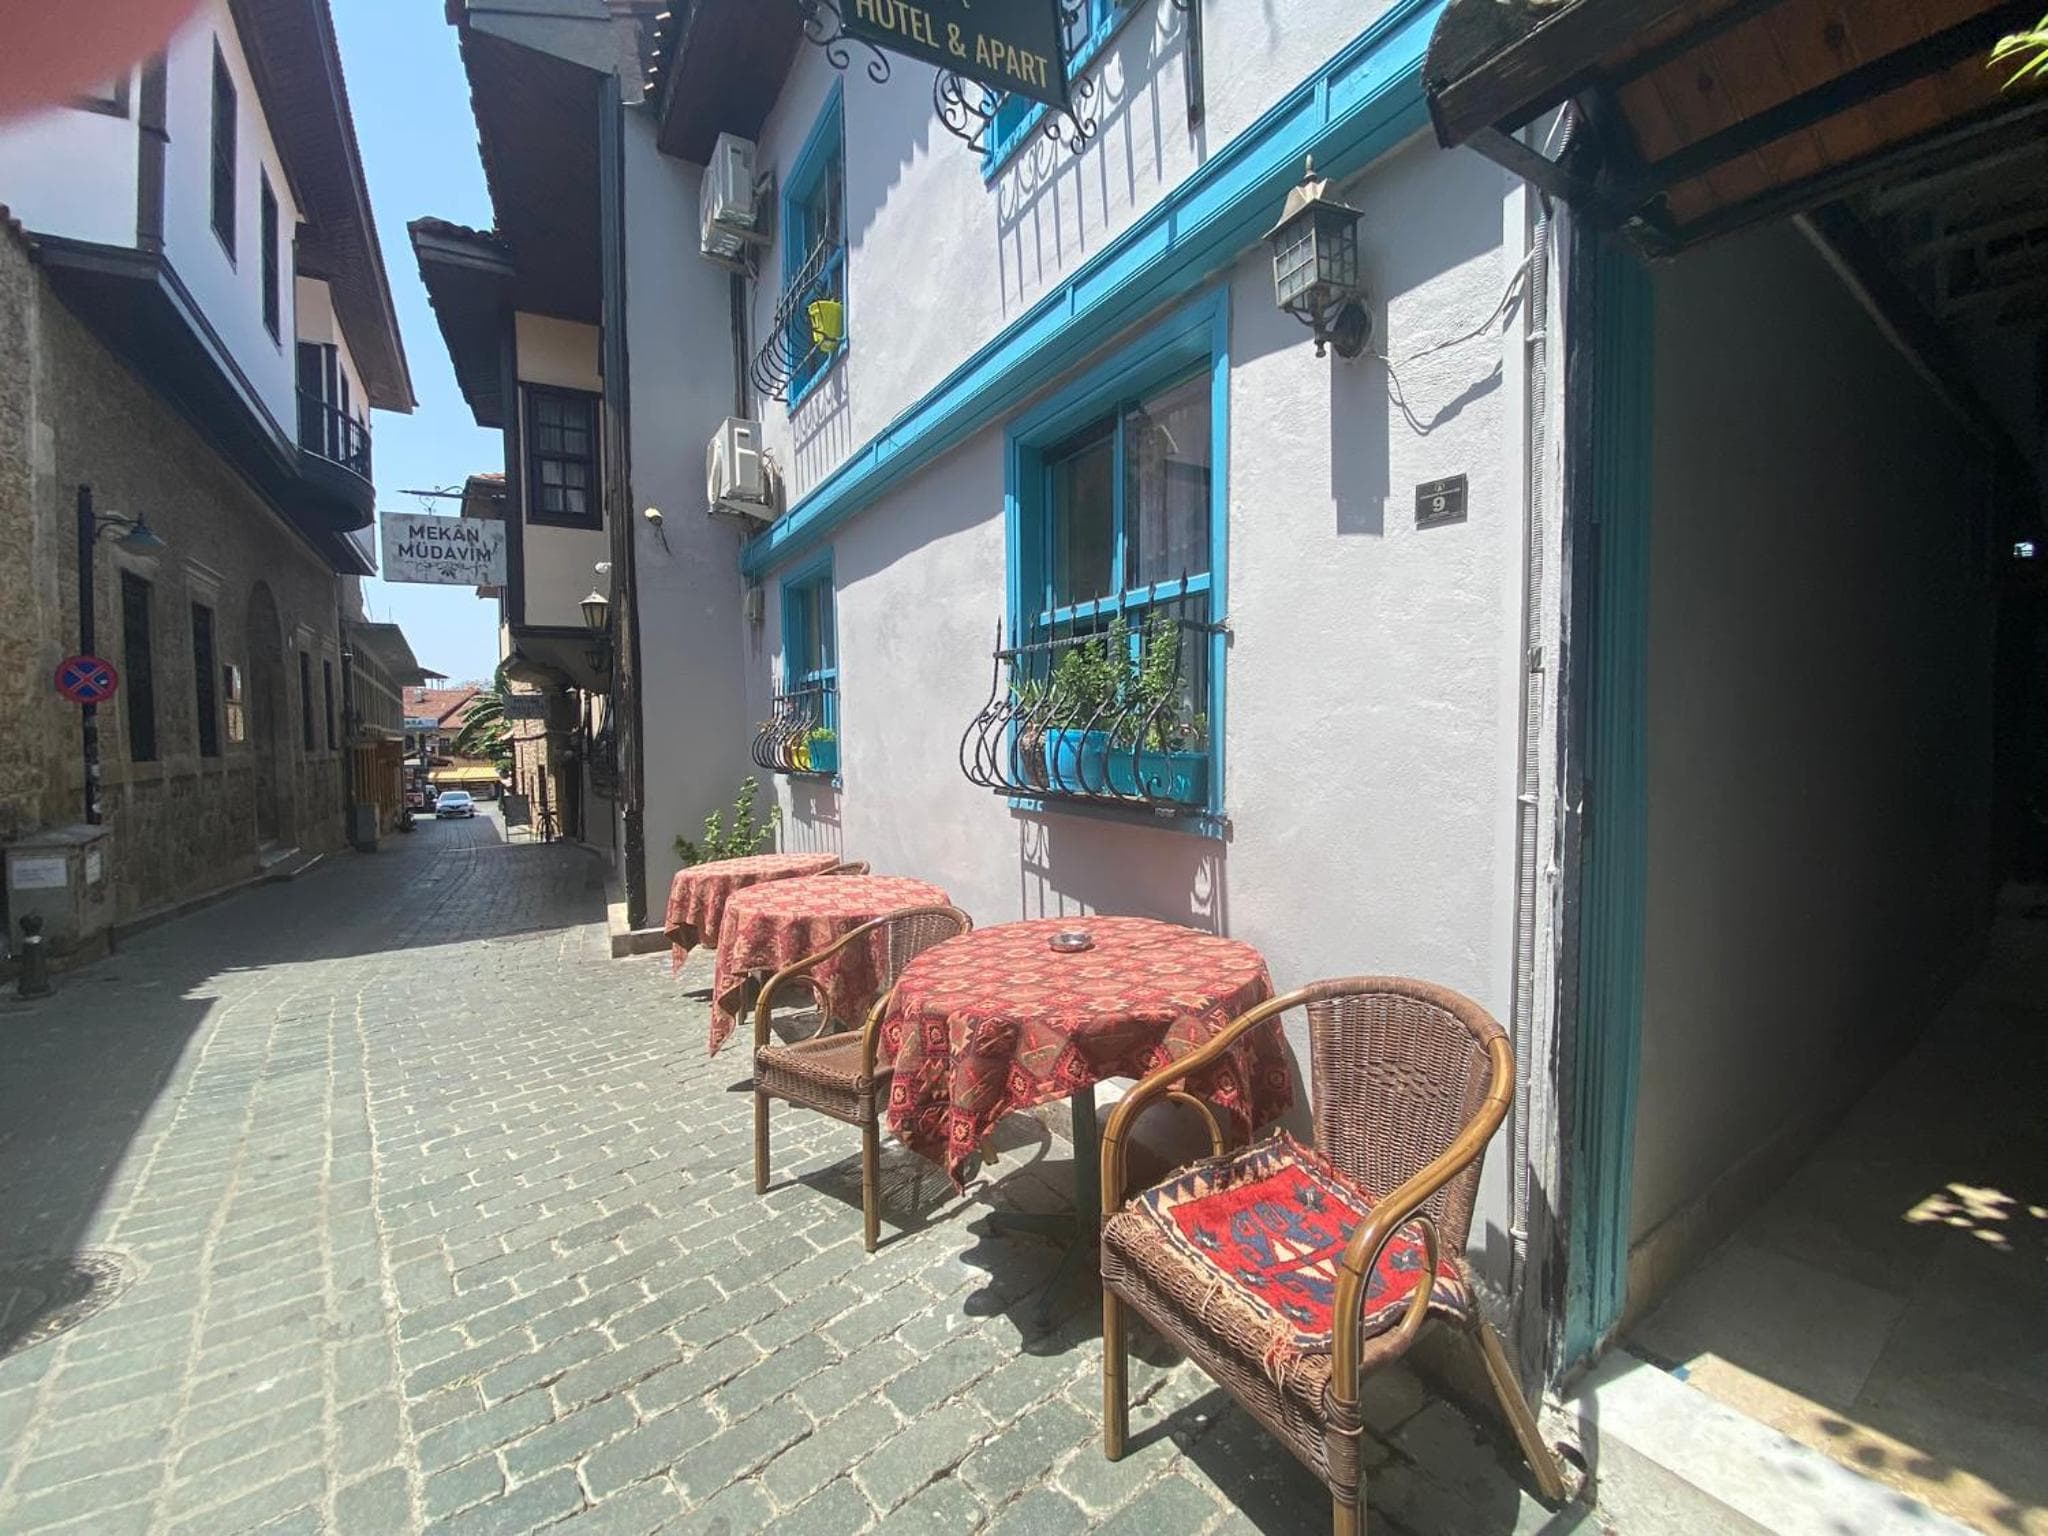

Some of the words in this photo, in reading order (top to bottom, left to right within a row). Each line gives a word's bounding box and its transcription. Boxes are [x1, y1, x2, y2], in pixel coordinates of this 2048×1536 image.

[856, 0, 940, 48] HOTEL
[947, 22, 967, 58] &
[976, 33, 1048, 88] APART
[1432, 496, 1446, 513] 9
[409, 524, 479, 543] MEKÂN
